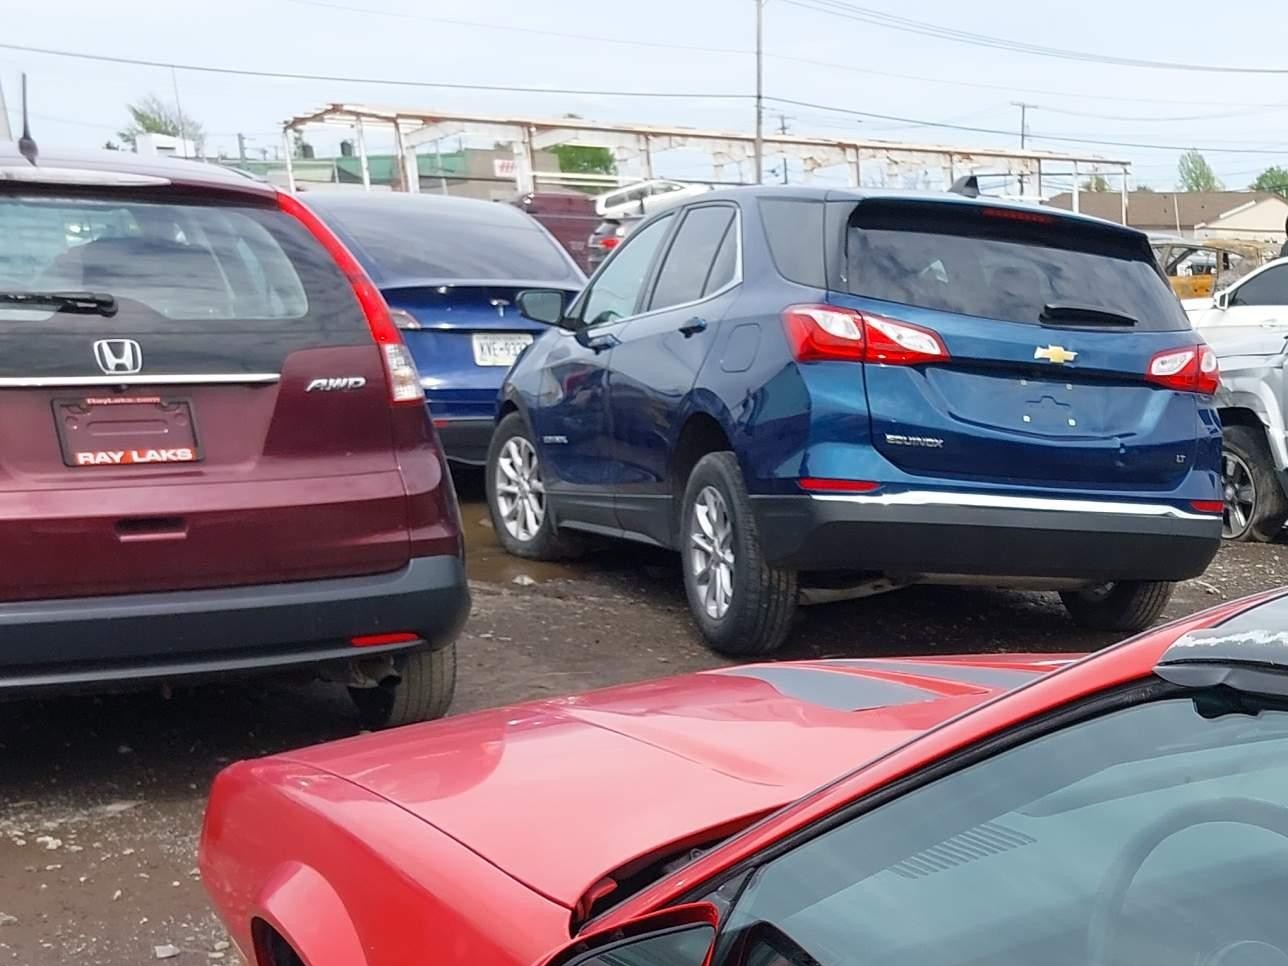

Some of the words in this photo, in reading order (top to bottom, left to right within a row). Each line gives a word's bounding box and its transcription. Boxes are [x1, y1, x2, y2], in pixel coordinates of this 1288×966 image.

[305, 376, 367, 393] AWD
[884, 433, 944, 449] EQUINOX
[78, 451, 125, 465] RAY
[131, 448, 193, 463] LAKS
